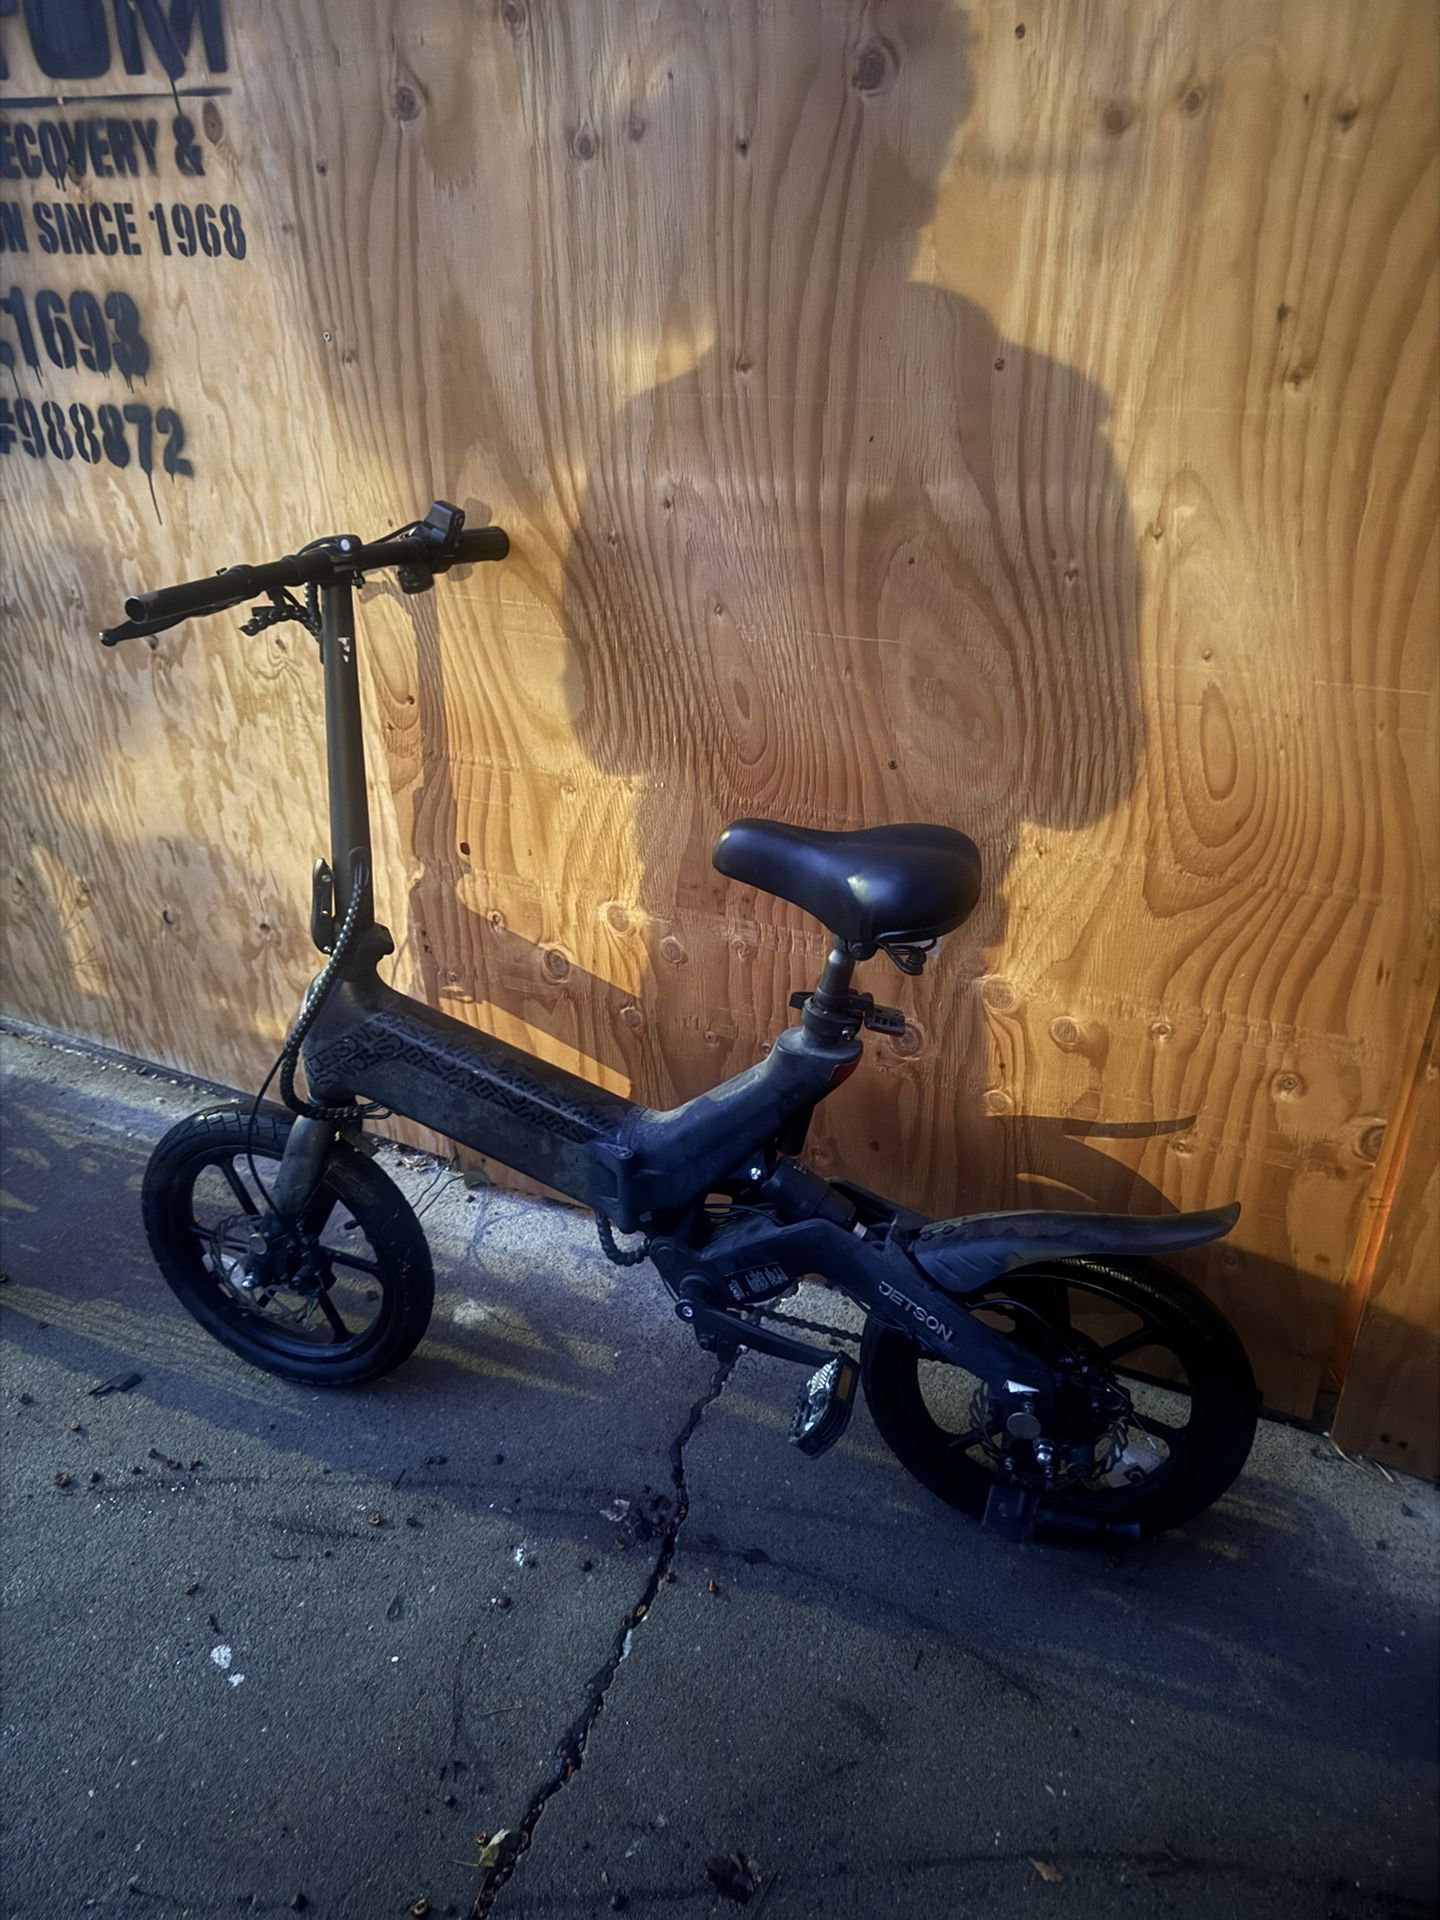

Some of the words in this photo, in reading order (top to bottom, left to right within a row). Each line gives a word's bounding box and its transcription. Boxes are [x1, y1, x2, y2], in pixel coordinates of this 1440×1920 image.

[172, 115, 205, 177] &
[0, 202, 29, 254] N
[33, 202, 142, 256] SINCE
[149, 203, 247, 260] 1968
[0, 286, 150, 378] 1693
[879, 1280, 953, 1341] JETSON
